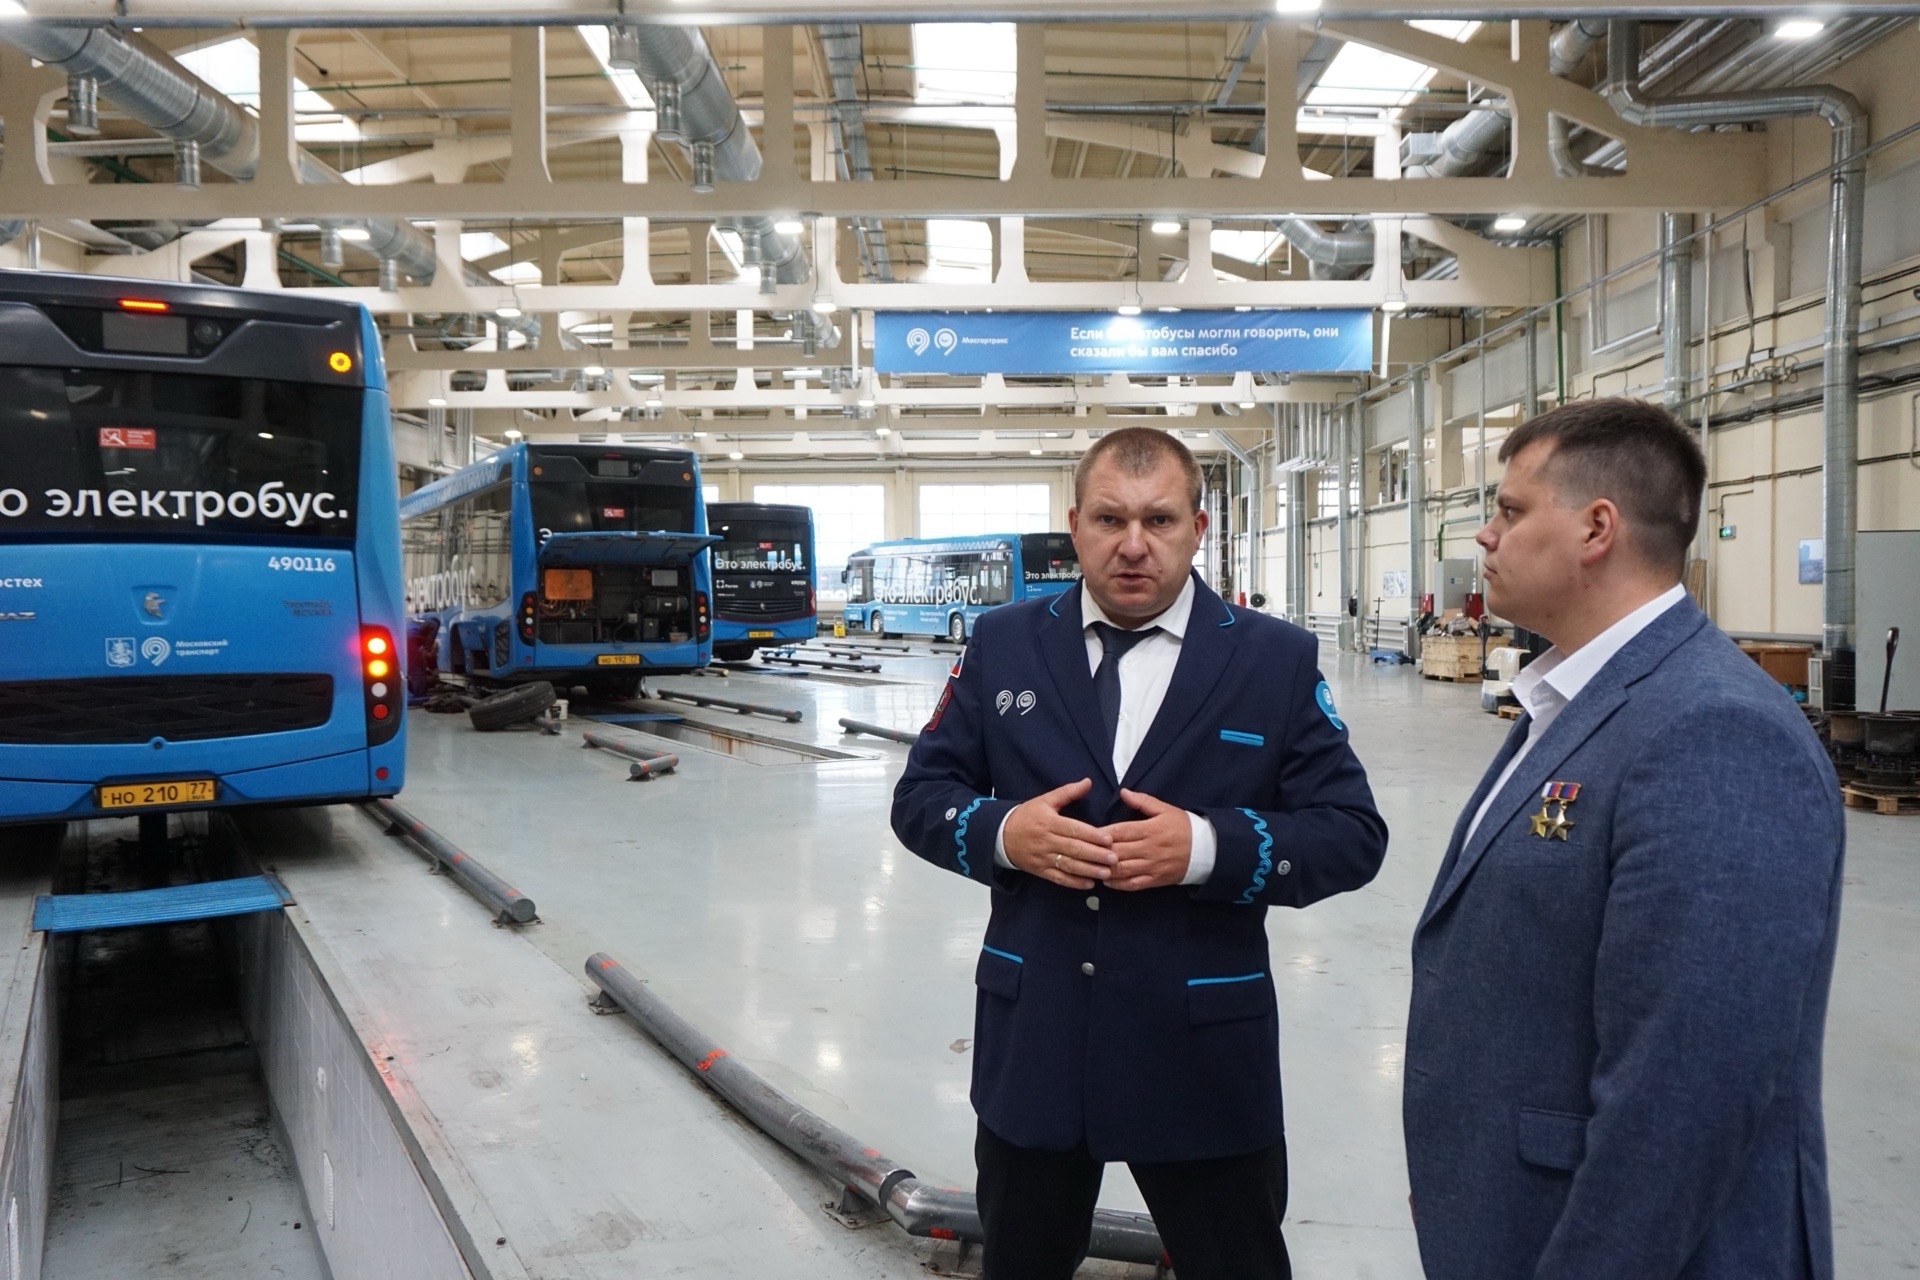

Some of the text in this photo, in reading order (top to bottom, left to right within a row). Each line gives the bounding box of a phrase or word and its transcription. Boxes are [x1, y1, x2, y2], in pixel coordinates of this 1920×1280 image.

[961, 336, 1009, 345] Мосгортранс
[1070, 327, 1104, 340] Если
[1132, 326, 1195, 341] тобусы
[1198, 328, 1241, 338] могли
[1243, 327, 1311, 340] говорить,
[1313, 327, 1339, 338] они
[1070, 343, 1238, 358] сказали бы вам спасибо
[45, 481, 348, 527] электробус.
[268, 556, 336, 571] 490116
[715, 558, 806, 571] Это электробус.
[1024, 571, 1039, 580] Это
[898, 576, 982, 610] электробус.
[175, 639, 229, 648] Московский
[175, 648, 220, 657] транспорт
[111, 782, 208, 805] НО 210 77
